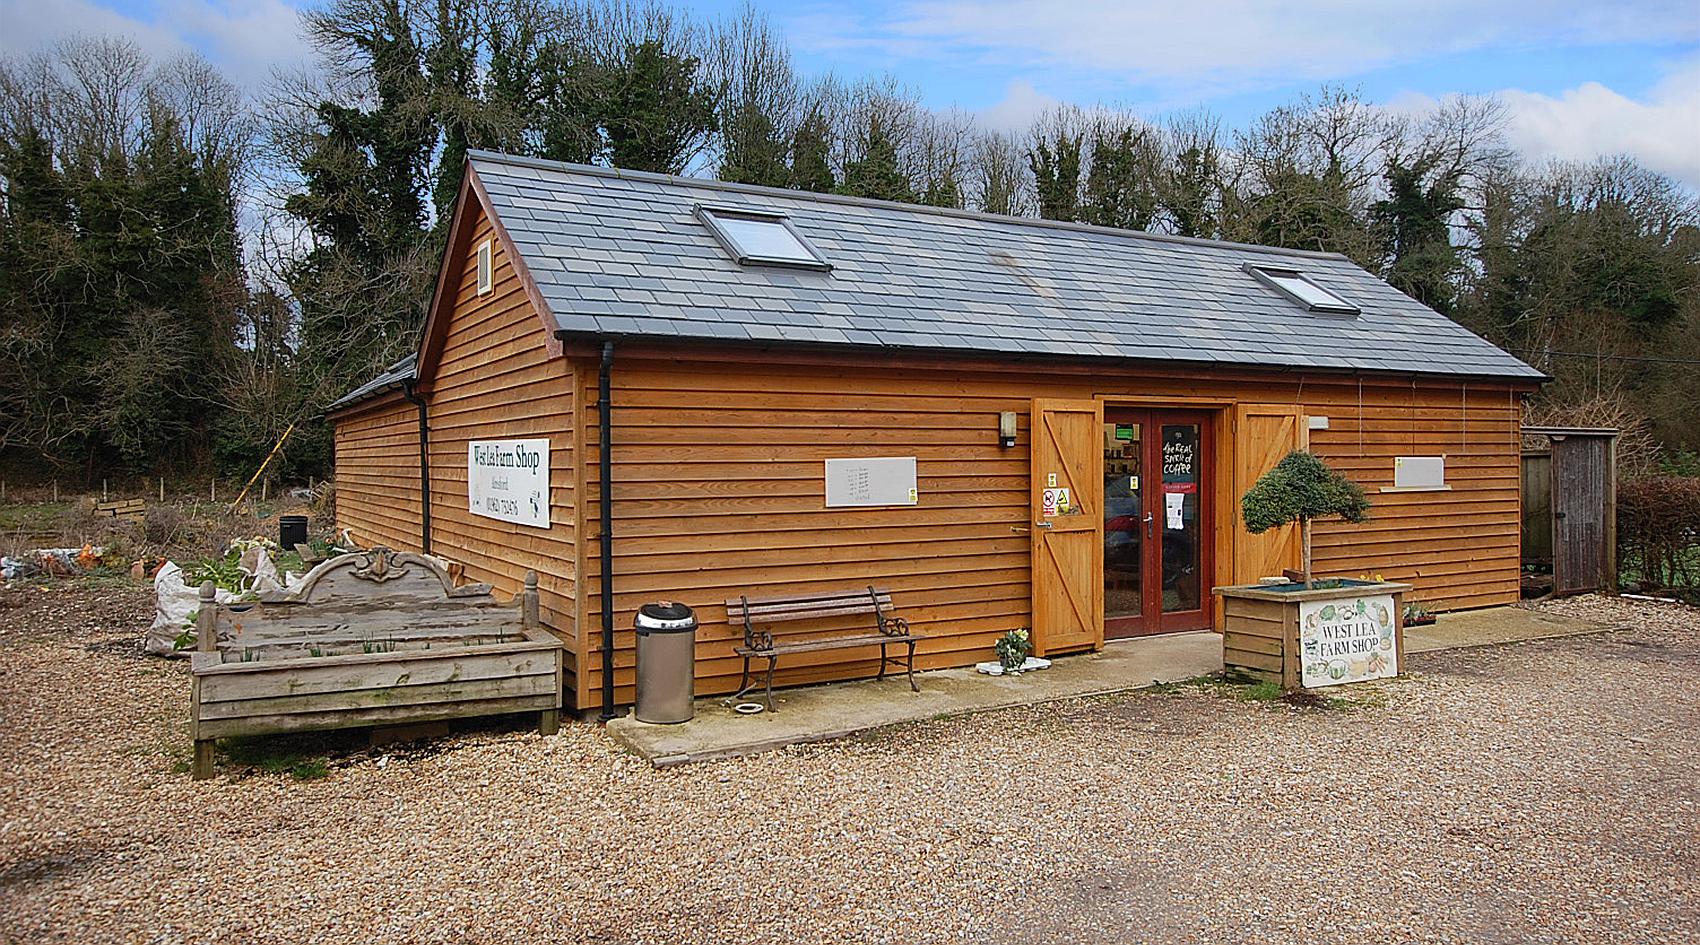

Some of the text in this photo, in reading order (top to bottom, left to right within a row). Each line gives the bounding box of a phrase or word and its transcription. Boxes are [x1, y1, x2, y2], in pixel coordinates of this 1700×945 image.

[474, 445, 487, 466] West
[495, 445, 514, 467] Farm
[516, 444, 539, 475] Shop
[1323, 622, 1376, 639] WEST LEA
[1320, 638, 1379, 657] FARM SHOP
